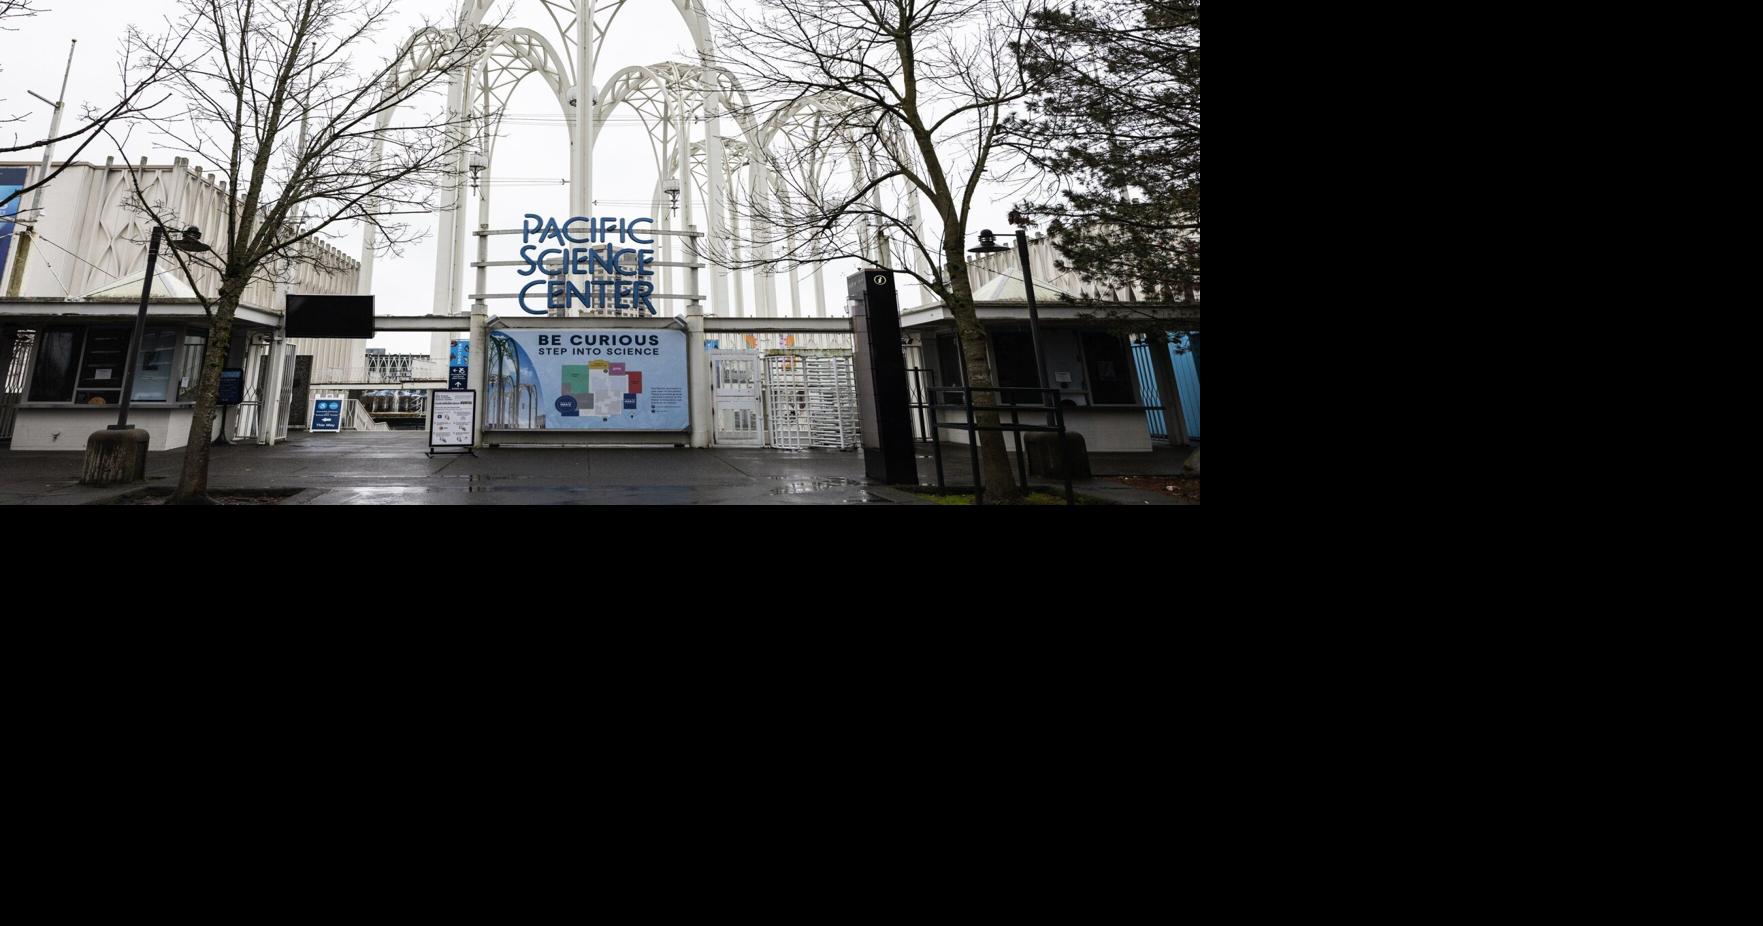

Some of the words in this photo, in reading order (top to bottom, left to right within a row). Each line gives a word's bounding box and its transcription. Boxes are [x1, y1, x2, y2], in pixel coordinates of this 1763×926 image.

[523, 213, 654, 246] PACIFIC
[517, 243, 654, 276] SCIENCE
[518, 280, 657, 315] CENTER
[538, 334, 561, 346] BE
[570, 334, 659, 346] CURIOUS
[538, 348, 567, 356] STEP
[572, 348, 601, 356] INTO
[606, 348, 660, 356] SCIENCE
